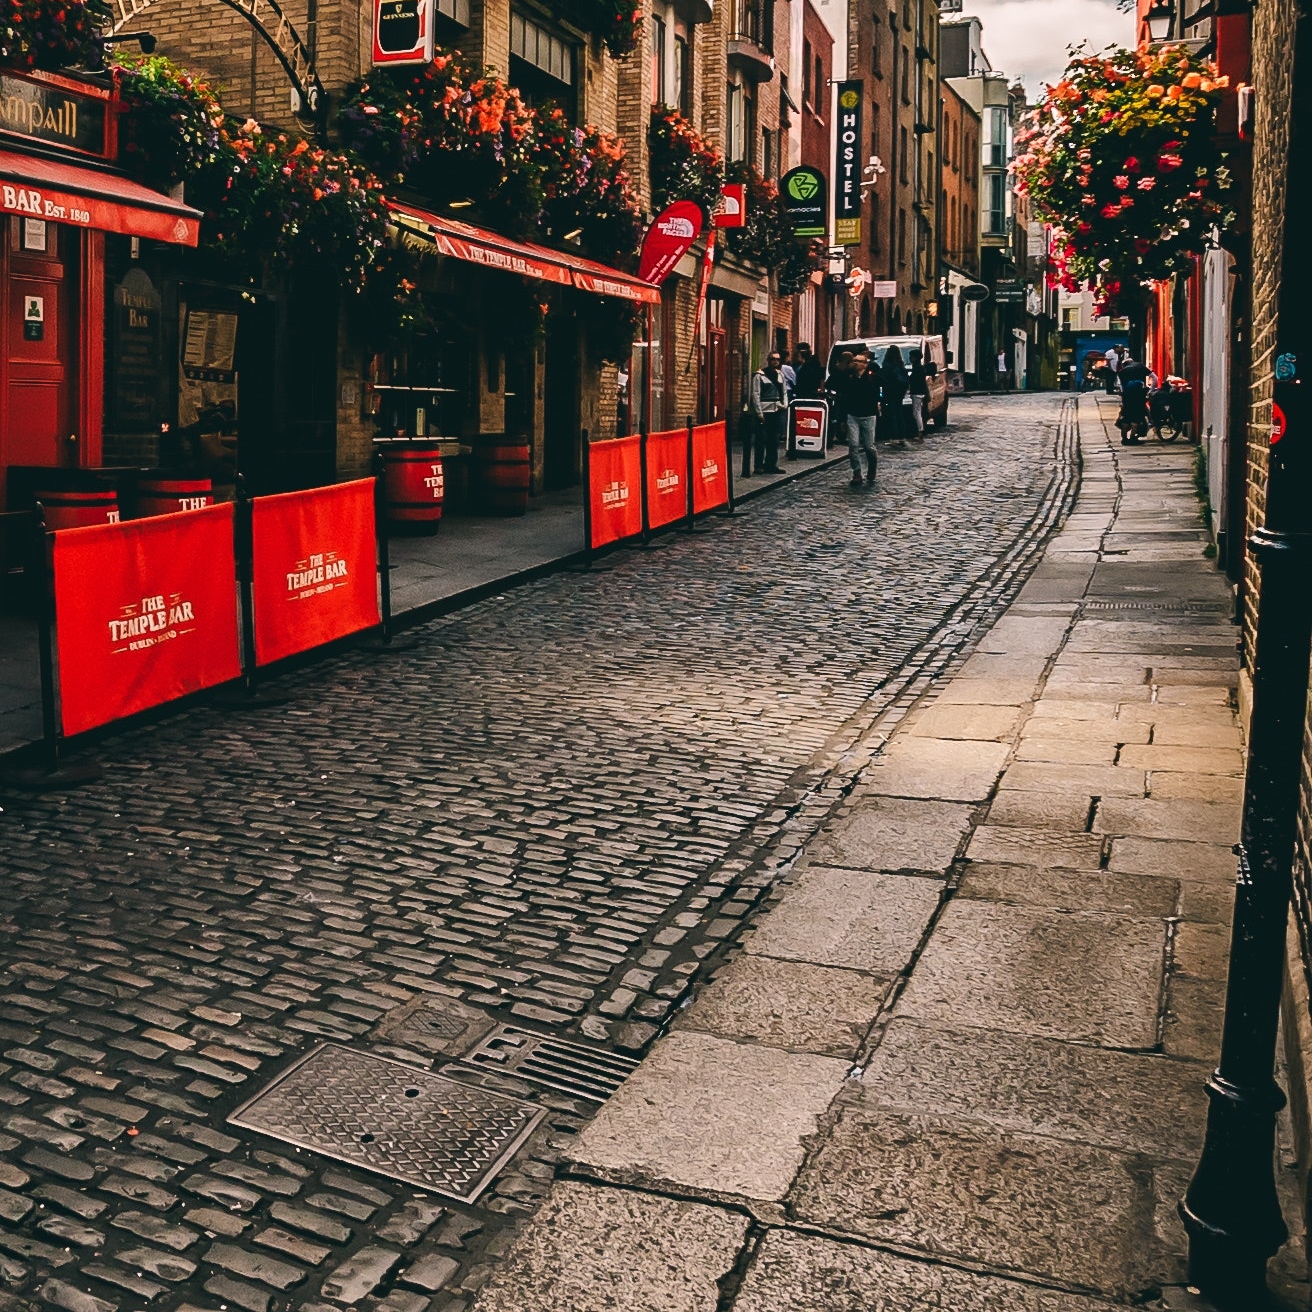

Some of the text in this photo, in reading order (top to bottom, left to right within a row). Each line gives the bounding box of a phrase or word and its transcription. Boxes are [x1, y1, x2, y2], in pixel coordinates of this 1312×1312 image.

[842, 114, 856, 209] HOSTEL
[3, 186, 44, 215] BAR
[70, 208, 90, 223] 1840
[179, 497, 207, 512] THE
[287, 560, 347, 590] TEMPLE BAR
[142, 595, 165, 613] THE
[109, 611, 166, 641] TEMPLE
